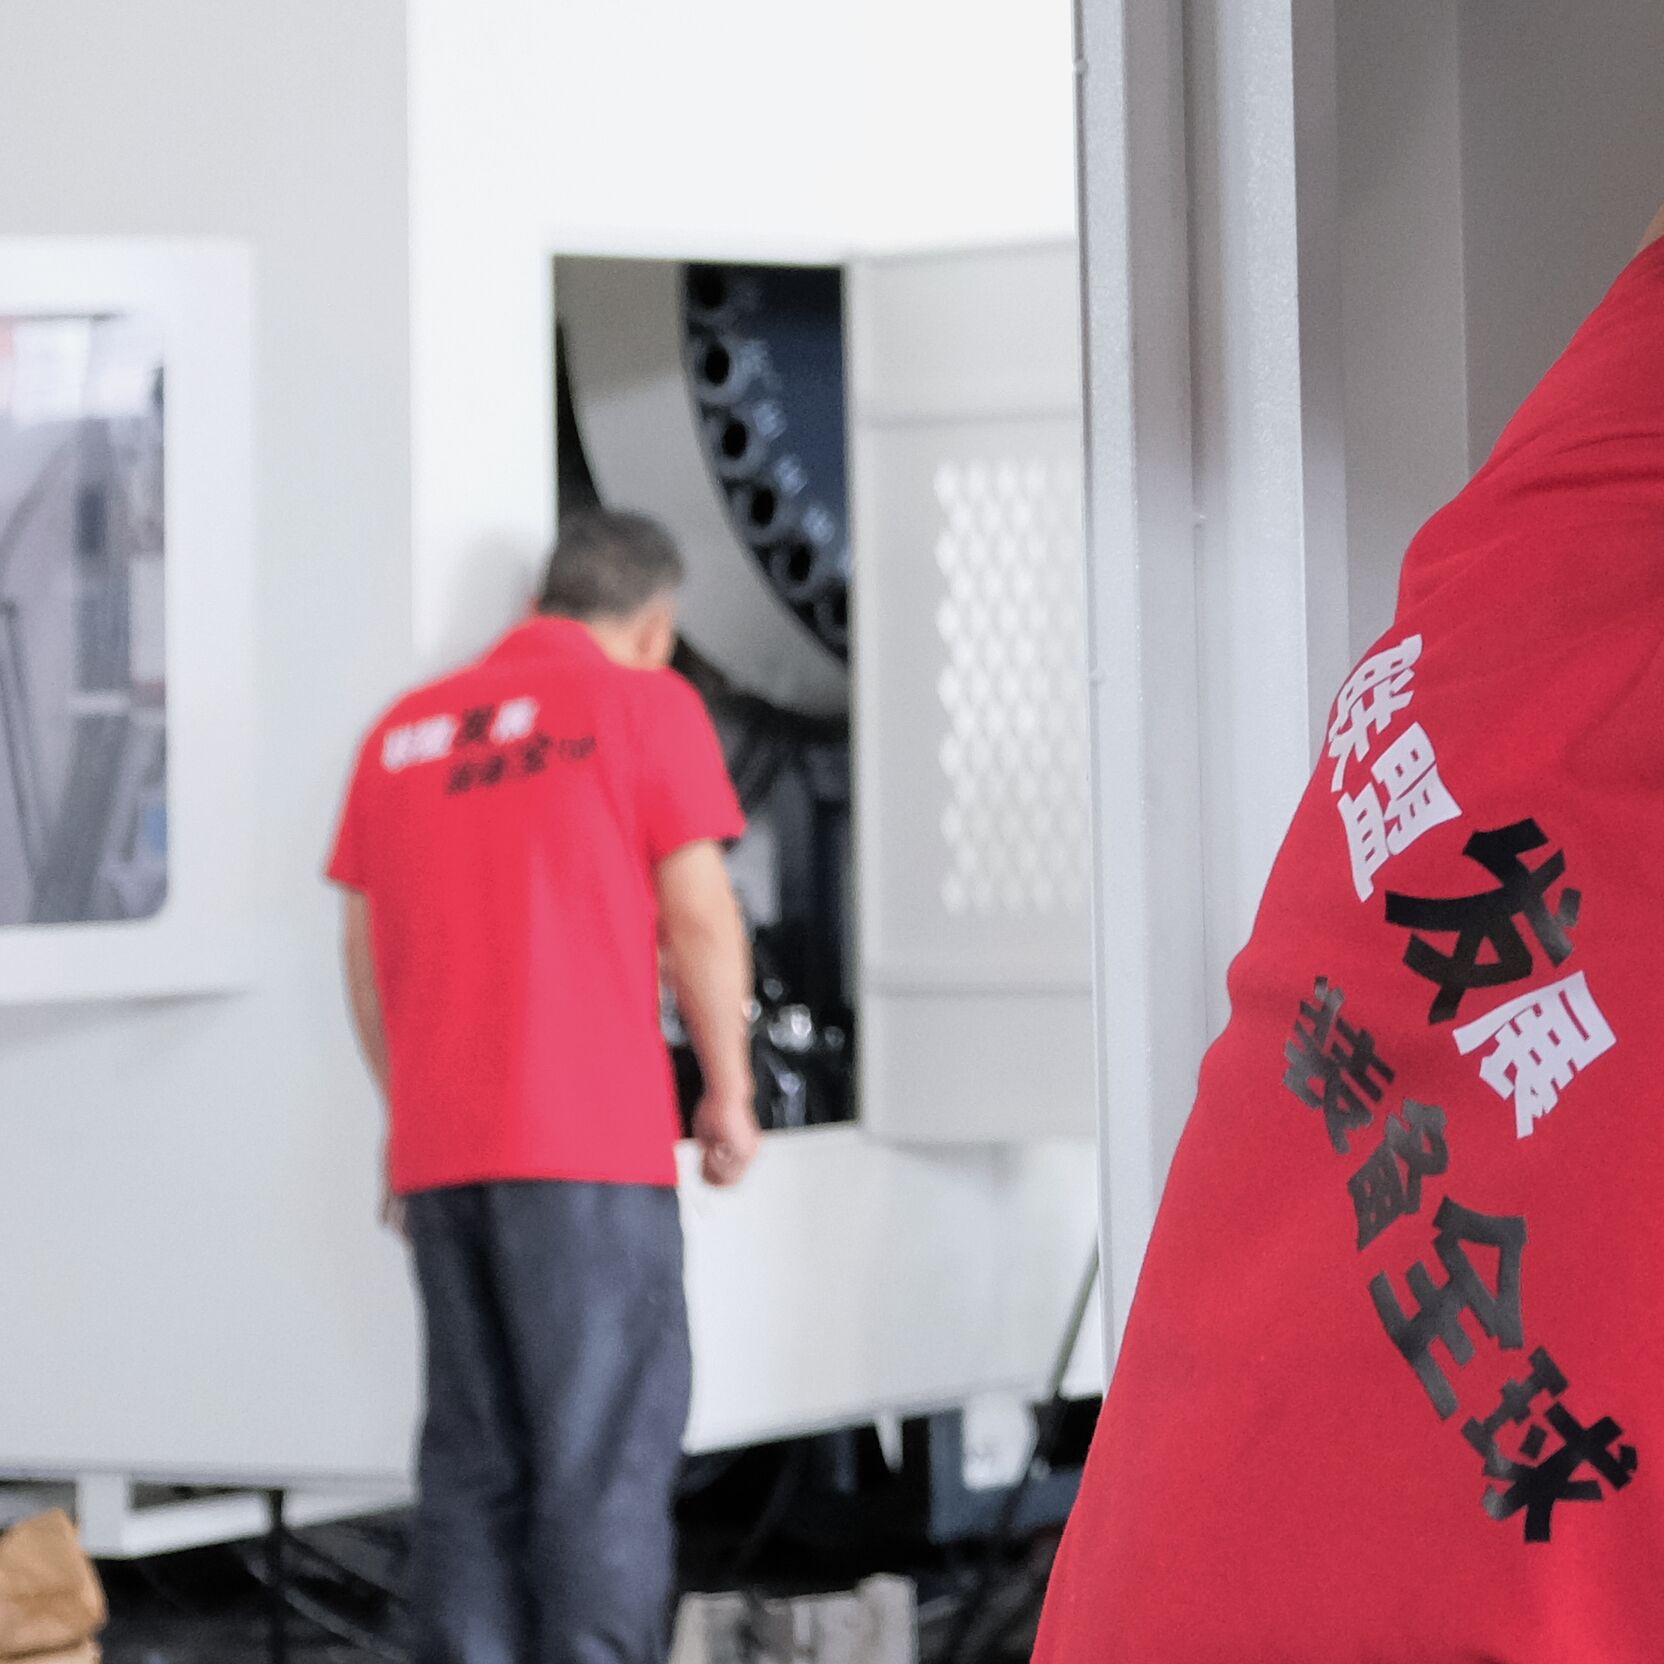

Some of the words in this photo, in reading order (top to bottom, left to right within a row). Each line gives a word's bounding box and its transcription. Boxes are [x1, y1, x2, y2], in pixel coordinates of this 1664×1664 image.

[1327, 634, 1617, 1140] 联盟发展
[1282, 975, 1638, 1543] 装备全球
